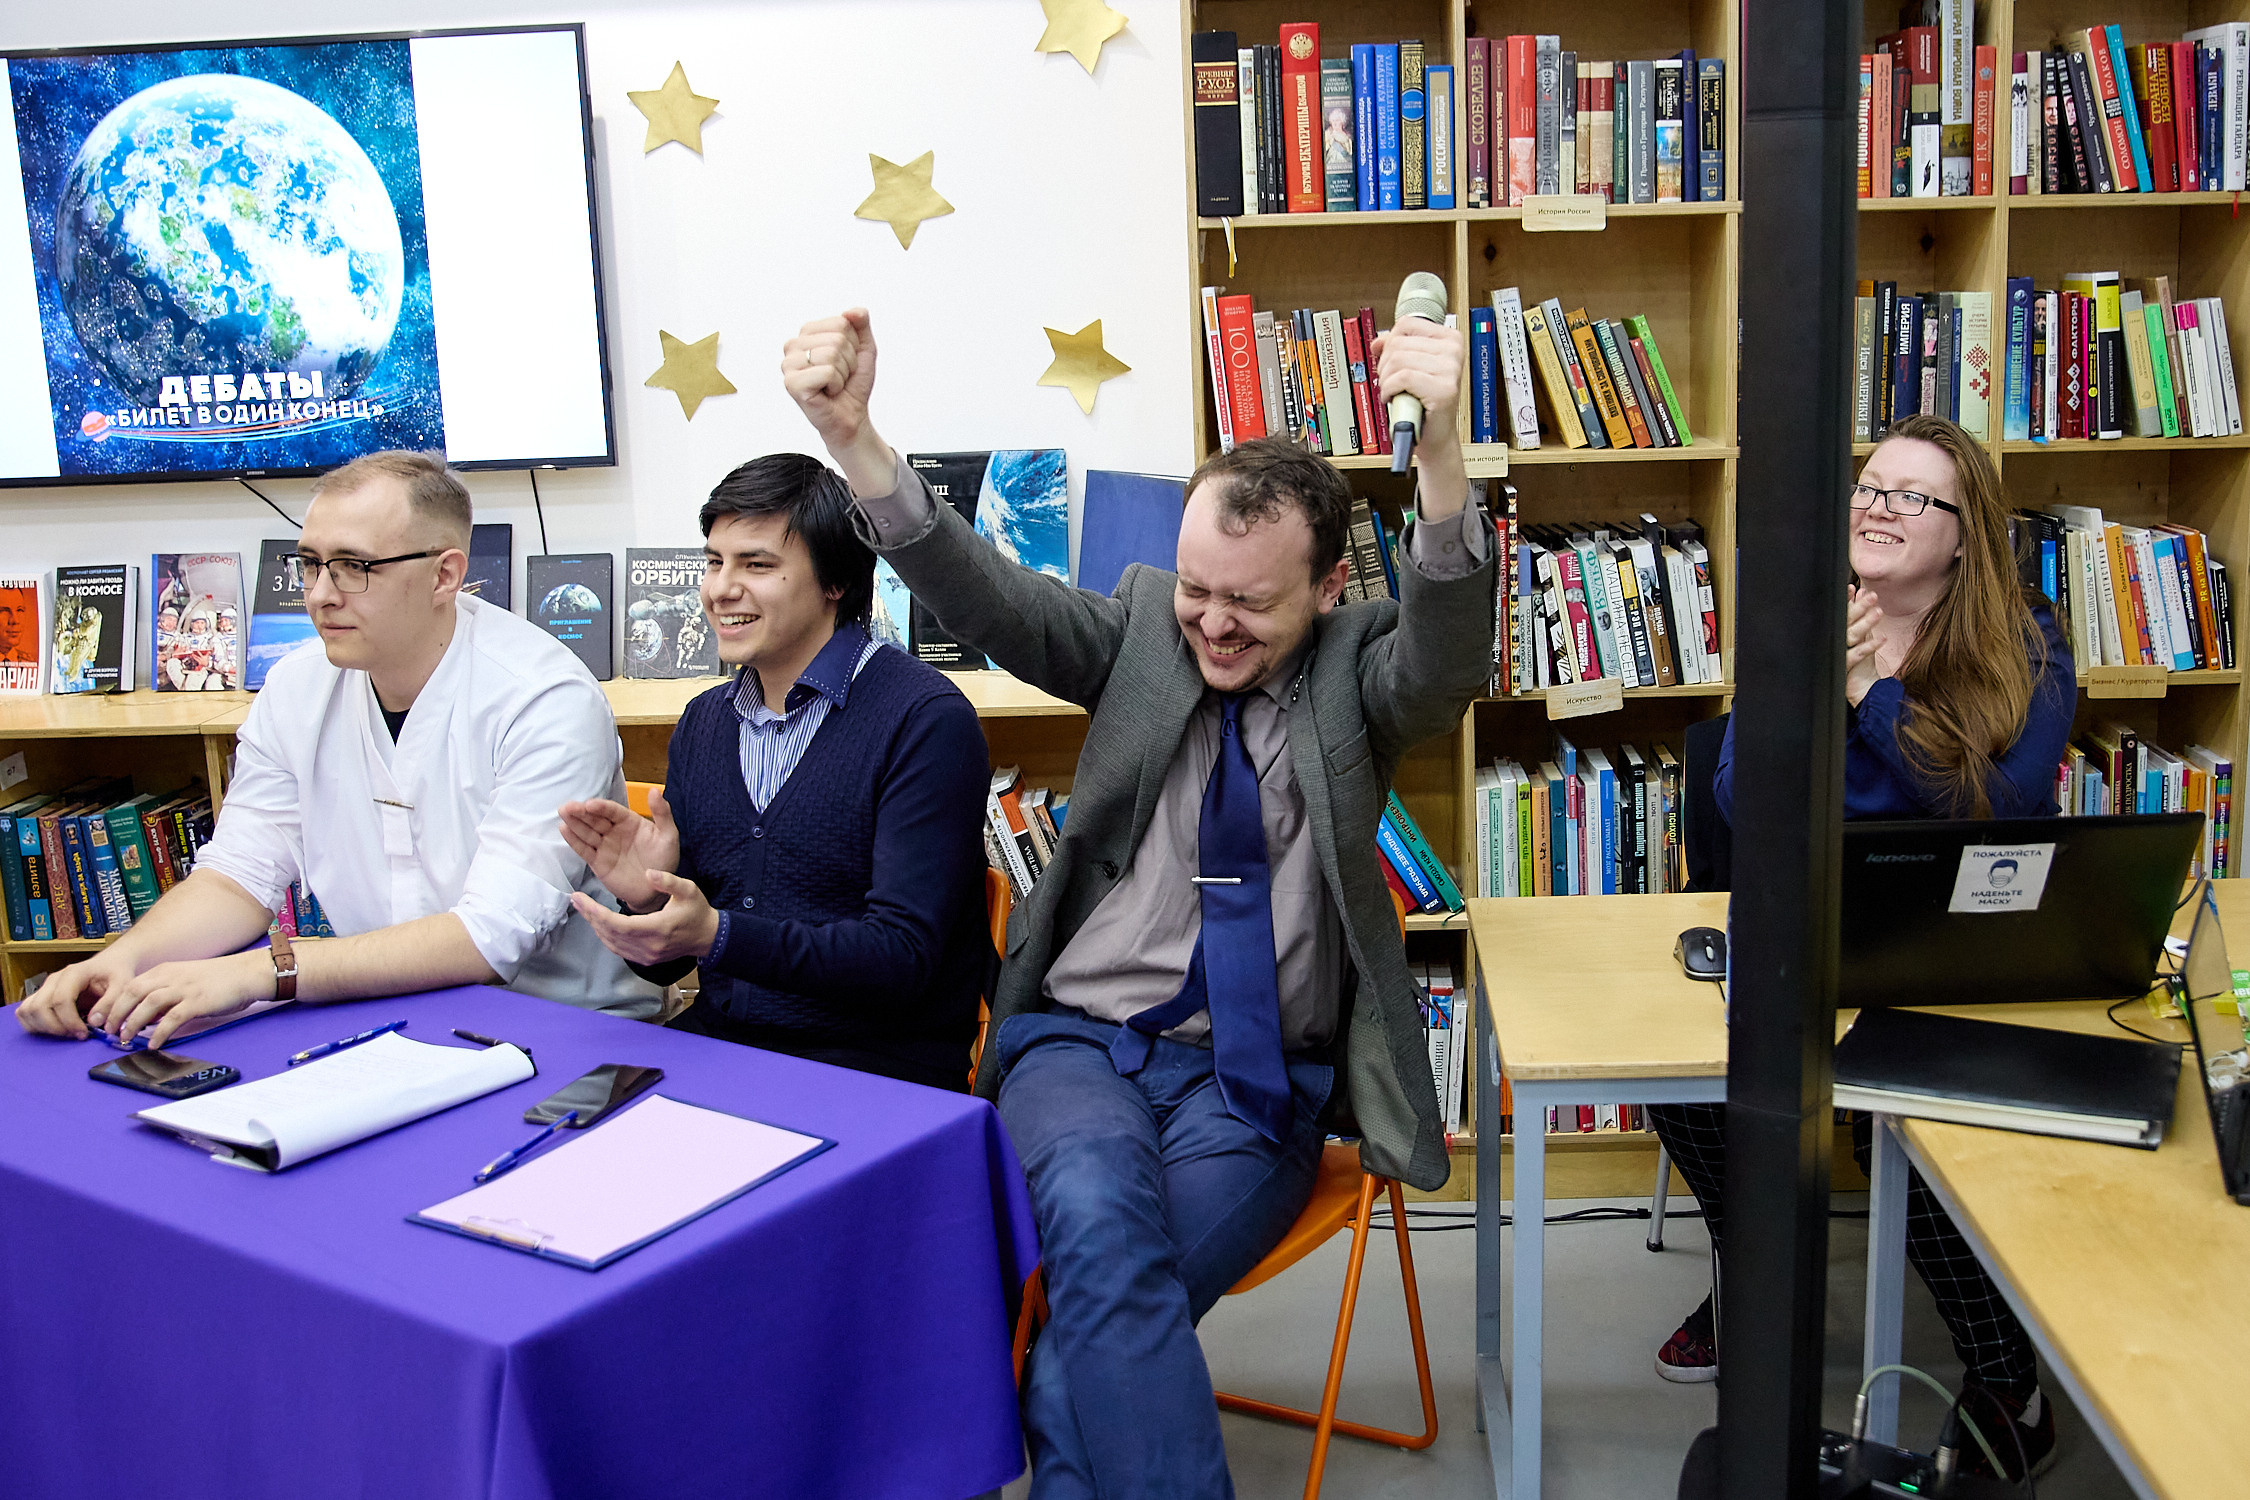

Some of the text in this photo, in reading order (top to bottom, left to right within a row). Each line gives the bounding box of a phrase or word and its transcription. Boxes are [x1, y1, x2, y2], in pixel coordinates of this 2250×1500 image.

[1198, 79, 1235, 90] РУСЬ
[1952, 38, 1962, 121] МИРОВАЯ ВОЙНА
[2099, 48, 2115, 96] ВОЛКОВ
[2158, 47, 2171, 123] ИЗОБИЛИЯ
[2208, 71, 2218, 111] ЛЕВАКИ
[1377, 54, 1388, 149] ИСТОРИЯ КУЛЬТУРЫ
[1471, 64, 1484, 145] СКОБЕЛЕВ
[1666, 77, 1675, 120] Москвы,
[1976, 90, 1988, 135] ЖУКОВ
[2079, 71, 2094, 127] Чужая девочка
[2149, 73, 2162, 124] СТРАНА
[2234, 69, 2244, 160] РЕВОЛЮЦИЯ ГАЙДАРА
[1297, 106, 1312, 161] ЕКАТЕРИНЫ
[1542, 106, 1553, 186] ИТАЛЬЯНСКАЯ
[1639, 70, 1648, 177] Правда Григории Распутине
[2113, 119, 2131, 170] СОЛОМОН
[1436, 136, 1447, 175] РОССИЯ
[2047, 124, 2058, 193] КОСЫГИН
[2070, 128, 2087, 187] ФУРЦЕВА
[1368, 181, 1376, 205] Триумф
[1538, 207, 1591, 216] История России
[1228, 326, 1250, 369] 100
[1552, 308, 1575, 365] НЕМЕЦКАЯ СИСТЕМА
[1899, 303, 1911, 355] ИМПЕРИЯ
[2071, 297, 2079, 360] ФАКТОРЫ
[1322, 317, 1340, 390] Цивилизация
[1584, 338, 1605, 380] СОКРОВИЩАМИ
[1598, 320, 1637, 408] ИСТОРИЯ ОДНОГО НЕМЦА
[1940, 332, 1950, 385] ПОЛТАВА
[2010, 305, 2023, 405] СТОЛКНОВЕНИЕ КУЛЬТУР
[2107, 340, 2115, 365] КУРЕНИЯ
[2223, 345, 2233, 391] РЕКЛАМА
[158, 371, 324, 407] ДЕБАТЫ
[1233, 371, 1244, 422] МЕДИЦИНЫ
[1238, 370, 1250, 427] ИЗ ИСТОРИИ
[1245, 369, 1256, 418] РАССКАЗОВ
[1481, 345, 1491, 428] ИСТОРИЯ ИТАЛЬЯНЦЕВ
[1858, 346, 1870, 422] Идея АМЕРИКИ
[2107, 366, 2115, 391] ИСТОРИЯ
[103, 397, 386, 428] «БИЛЕТ В ОДИН КОНЕЦ»
[1602, 390, 1620, 418] ОХОТНИКИ
[1657, 402, 1675, 441] ФИДЕЛЬ КАСТРО
[1477, 455, 1504, 463] история
[632, 560, 708, 569] КОСМИЧЕСКИ
[2099, 549, 2112, 603] СТАТИСТИКА
[2115, 536, 2124, 574] статистика
[2194, 552, 2208, 602] PR на 100%
[68, 585, 122, 596] В КОСМОСЕ
[1586, 550, 1607, 610] ВУЛЬФ
[2088, 576, 2096, 624] МИЛЛИАРДЕРЫ
[2181, 569, 2195, 620] HR-брендинг
[1604, 562, 1636, 681] МАШИНА ПЕСЕН
[1630, 611, 1647, 658] РЭП АТАКА
[1653, 606, 1664, 636] ПОЛЧАСА
[0, 668, 37, 690] АРИН
[1566, 694, 1602, 705] Искусство
[2091, 677, 2165, 686] Бизнес Кураторство
[1633, 782, 1644, 820] сознания
[2125, 762, 2133, 805] ПОДРОСТКА
[1521, 810, 1529, 845] ХУДОЖНИКА
[1589, 822, 1597, 845] ближе
[1604, 818, 1612, 859] РАССКАЗЫВАЕТ
[1634, 822, 1646, 857] Ступени
[1668, 812, 1677, 843] ПСИХОЛ
[2217, 802, 2226, 847] ДИСЦИПЛИНА
[1383, 831, 1429, 898] БУДУЩЕЕ РАЗУМА
[1866, 853, 1936, 863] lenovo
[1973, 849, 2042, 858] ПОЖАЛУЙСТА
[28, 856, 41, 898] аэлита
[53, 883, 67, 910] АРЕС
[109, 868, 132, 928] ЛАЗАРЧУК
[1971, 890, 2023, 898] НАДЕНЬТЕ
[83, 905, 93, 924] Выйти
[1433, 1041, 1444, 1083] Японии
